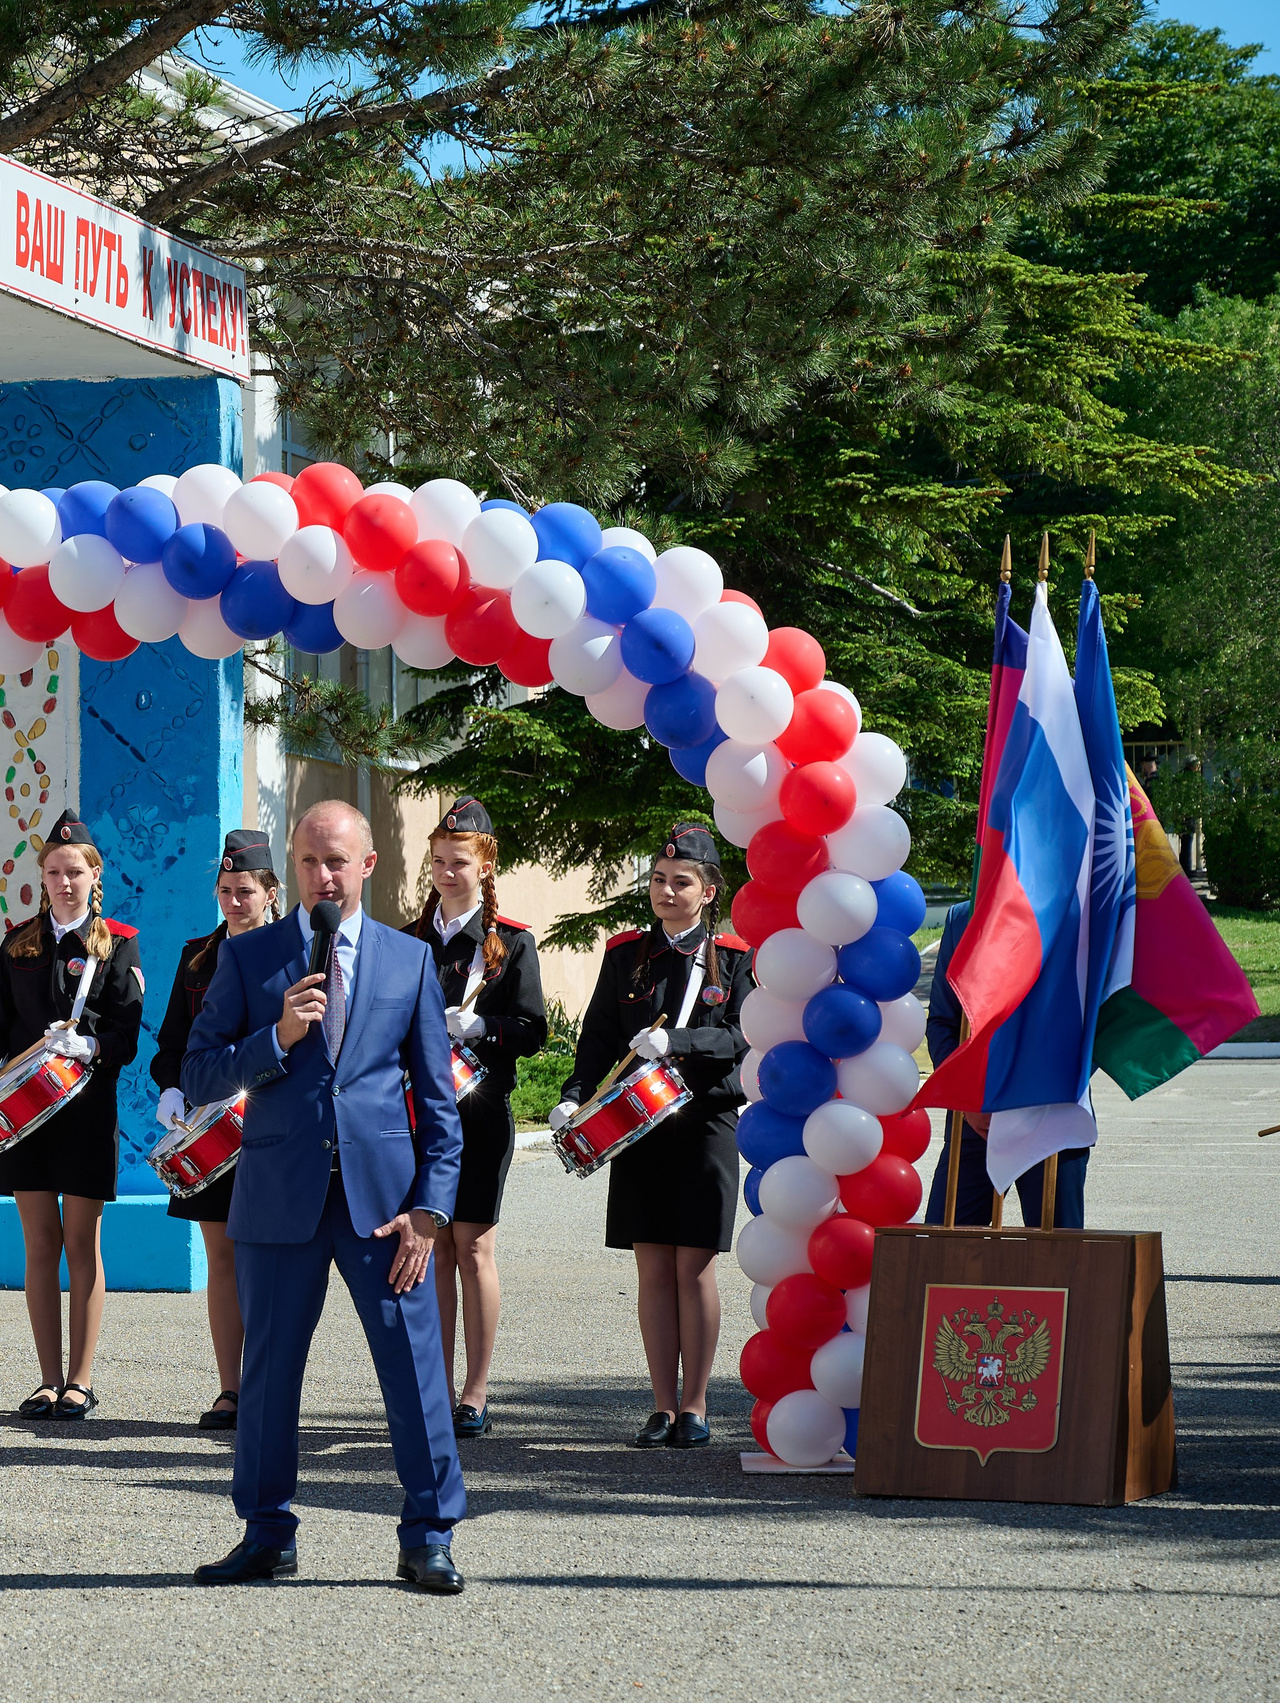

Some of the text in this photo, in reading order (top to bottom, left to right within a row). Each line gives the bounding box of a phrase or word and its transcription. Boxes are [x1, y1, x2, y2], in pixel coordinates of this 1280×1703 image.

[15, 189, 65, 285] ВАШ
[75, 215, 129, 309] ПУТЬ
[141, 245, 155, 322] К
[166, 257, 246, 356] УСПЕХУ!
